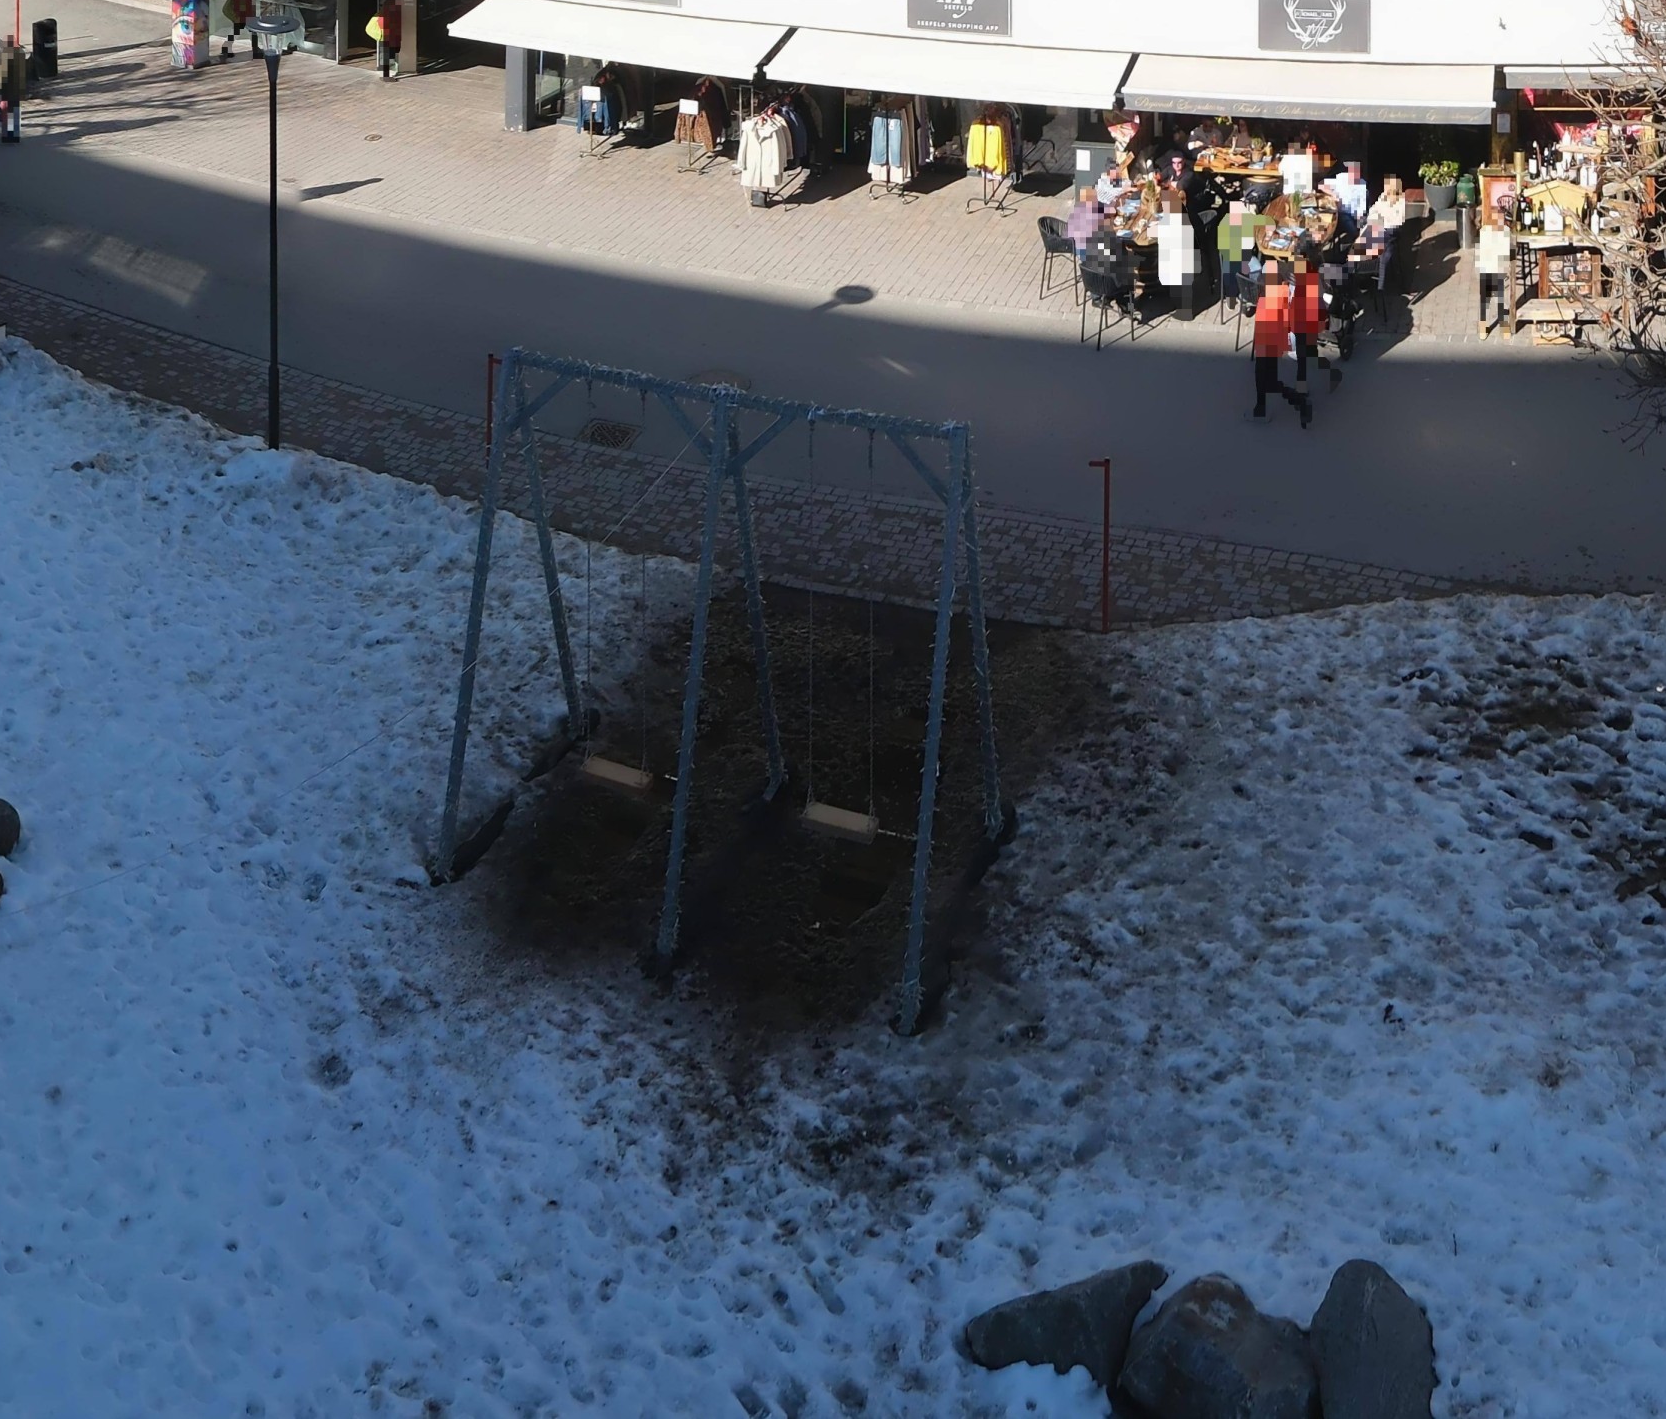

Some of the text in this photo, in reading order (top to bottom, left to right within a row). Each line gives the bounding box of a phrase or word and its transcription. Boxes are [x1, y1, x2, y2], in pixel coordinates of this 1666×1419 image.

[944, 4, 973, 12] SEEFELD
[916, 20, 946, 28] SEEFELD
[948, 22, 983, 31] SHOPPING
